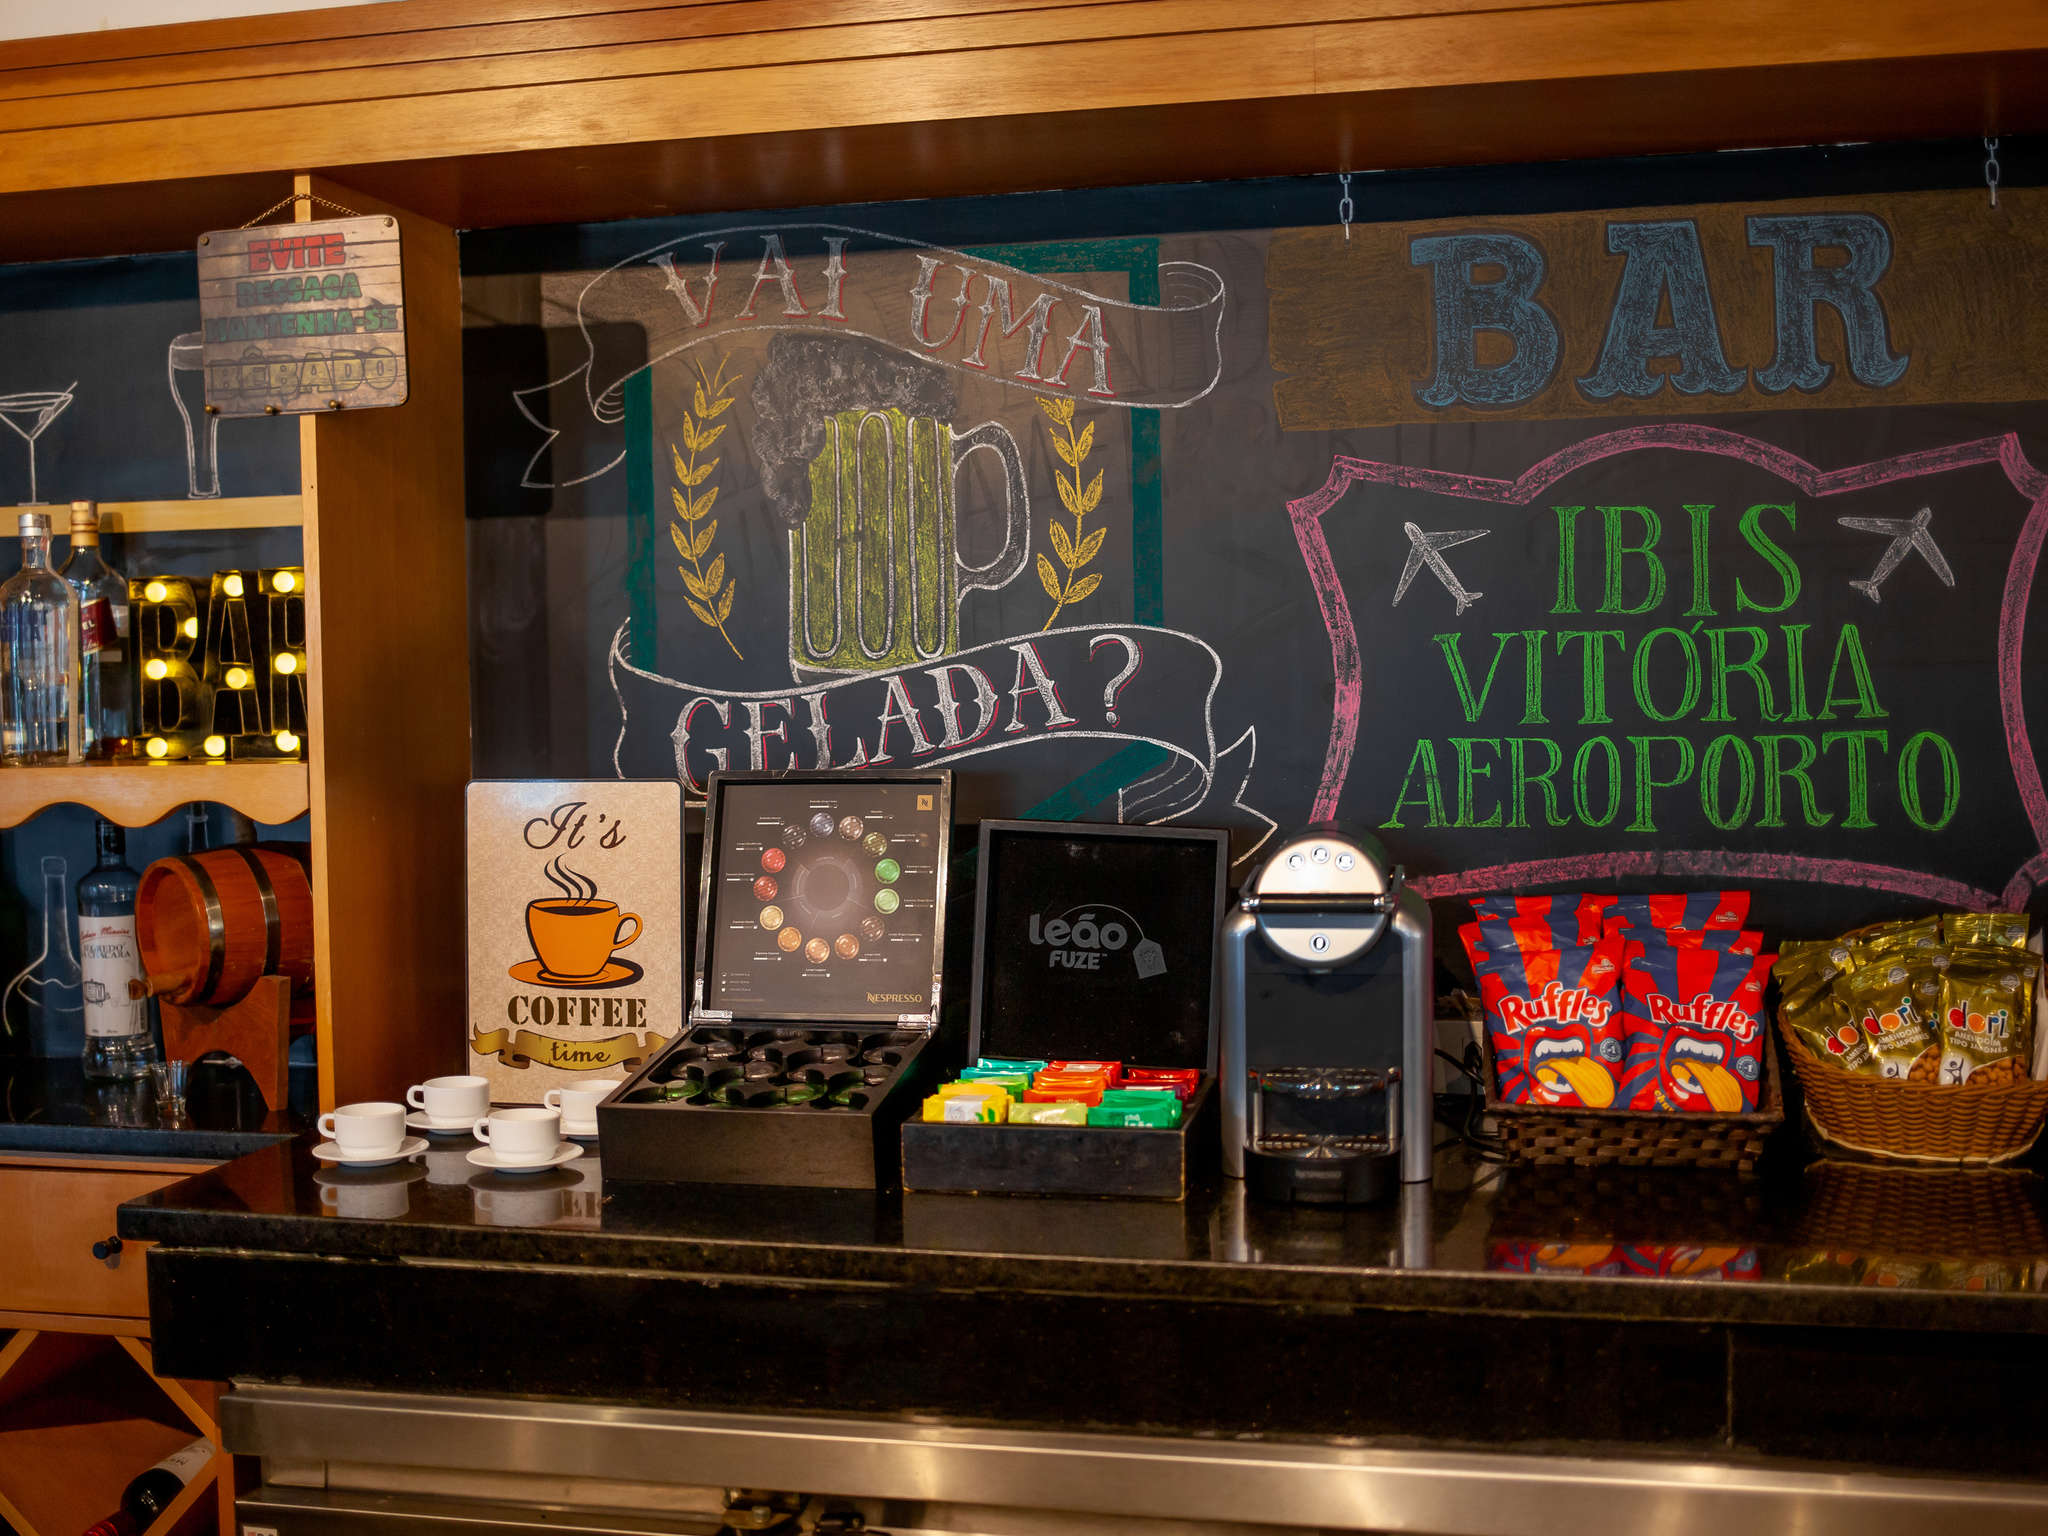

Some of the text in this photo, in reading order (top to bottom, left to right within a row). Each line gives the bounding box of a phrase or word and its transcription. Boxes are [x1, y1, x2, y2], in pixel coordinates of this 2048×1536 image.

[247, 232, 346, 272] EVITE
[236, 272, 363, 308] RESSACA
[1410, 214, 1910, 407] BAR
[204, 308, 398, 343] MANTENHA-SE
[648, 234, 1116, 396] VAI UMA
[207, 346, 398, 398] BÊBADO
[1548, 502, 1802, 616] IBIS
[129, 568, 308, 760] BAR
[1431, 621, 1890, 726] VITÓRIA
[1378, 730, 1960, 832] AEROPORTO
[523, 801, 627, 850] It's
[1029, 912, 1128, 951] leão
[507, 995, 648, 1028] COFFEE
[866, 992, 923, 1004] NESPRESSO
[1497, 980, 1613, 1035] Ruffles
[1646, 993, 1760, 1042] Ruffles
[1862, 996, 1922, 1036] dori
[1948, 1000, 2010, 1038] dori
[550, 1040, 612, 1063] time
